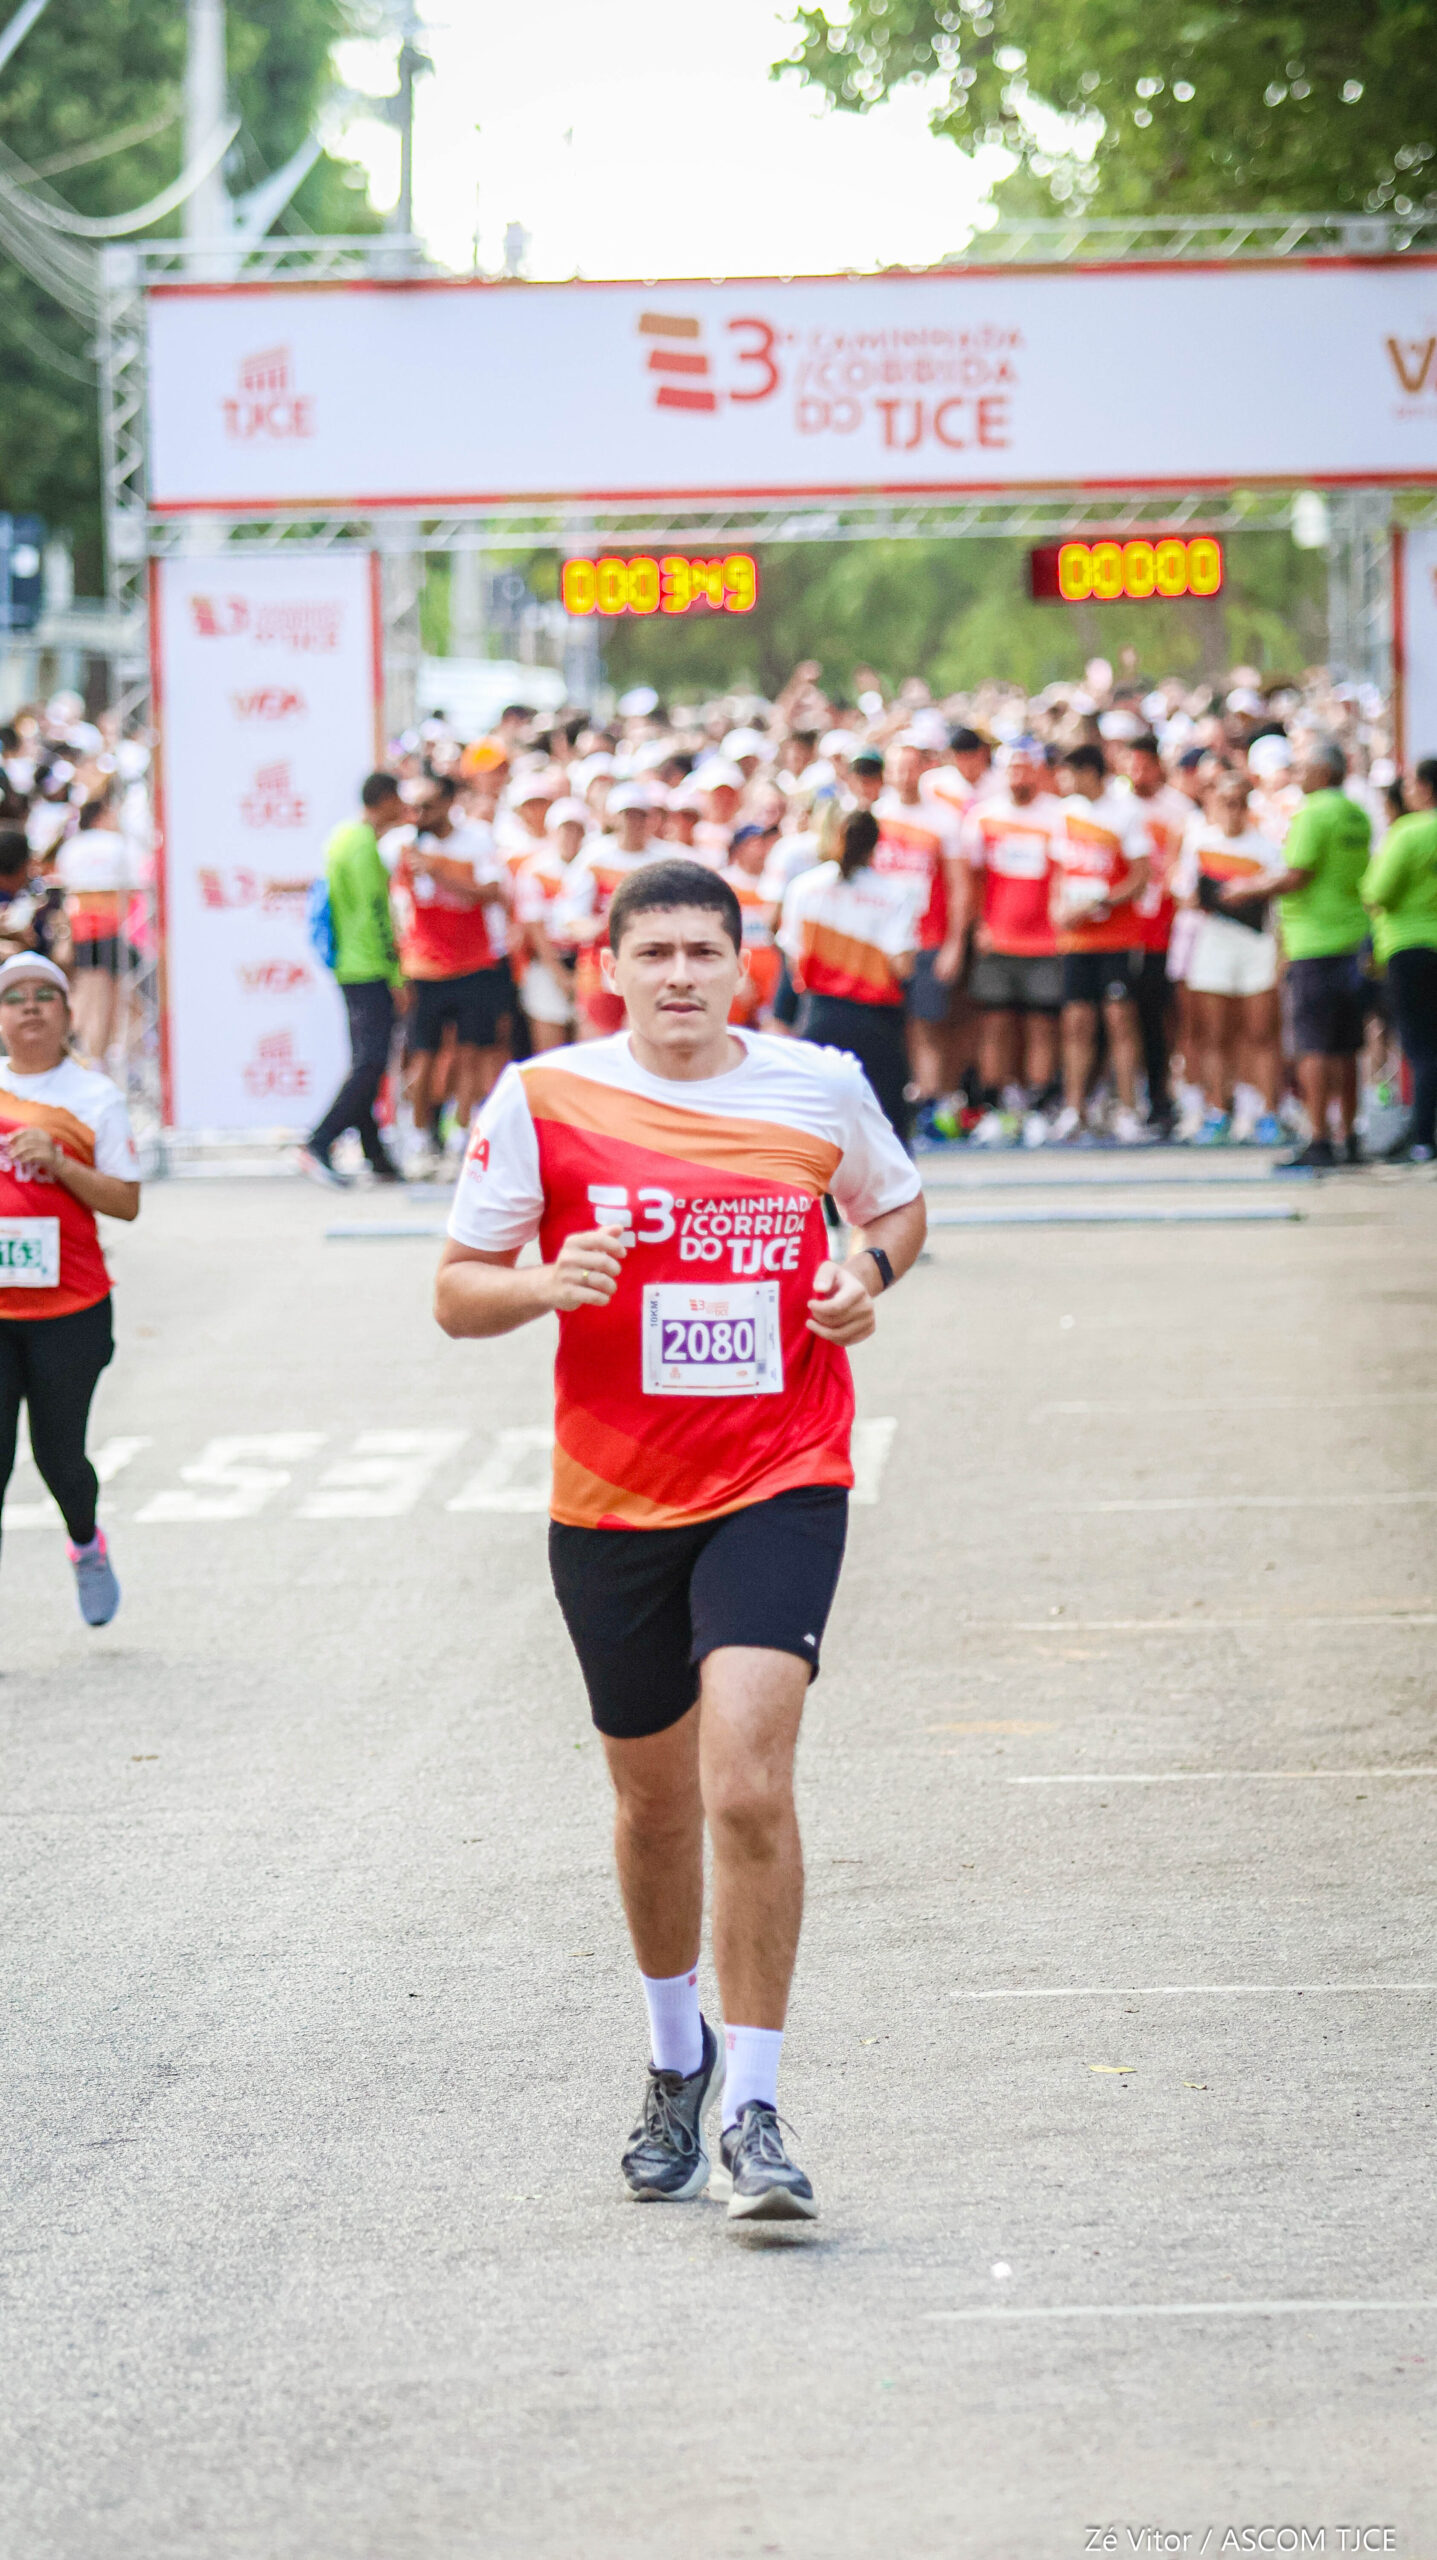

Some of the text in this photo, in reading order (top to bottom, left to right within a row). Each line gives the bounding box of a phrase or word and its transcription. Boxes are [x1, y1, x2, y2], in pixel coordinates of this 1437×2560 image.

[796, 396, 1014, 451] DO TJCE
[680, 1236, 801, 1275] DO TJCE
[664, 1320, 754, 1362] 2080
